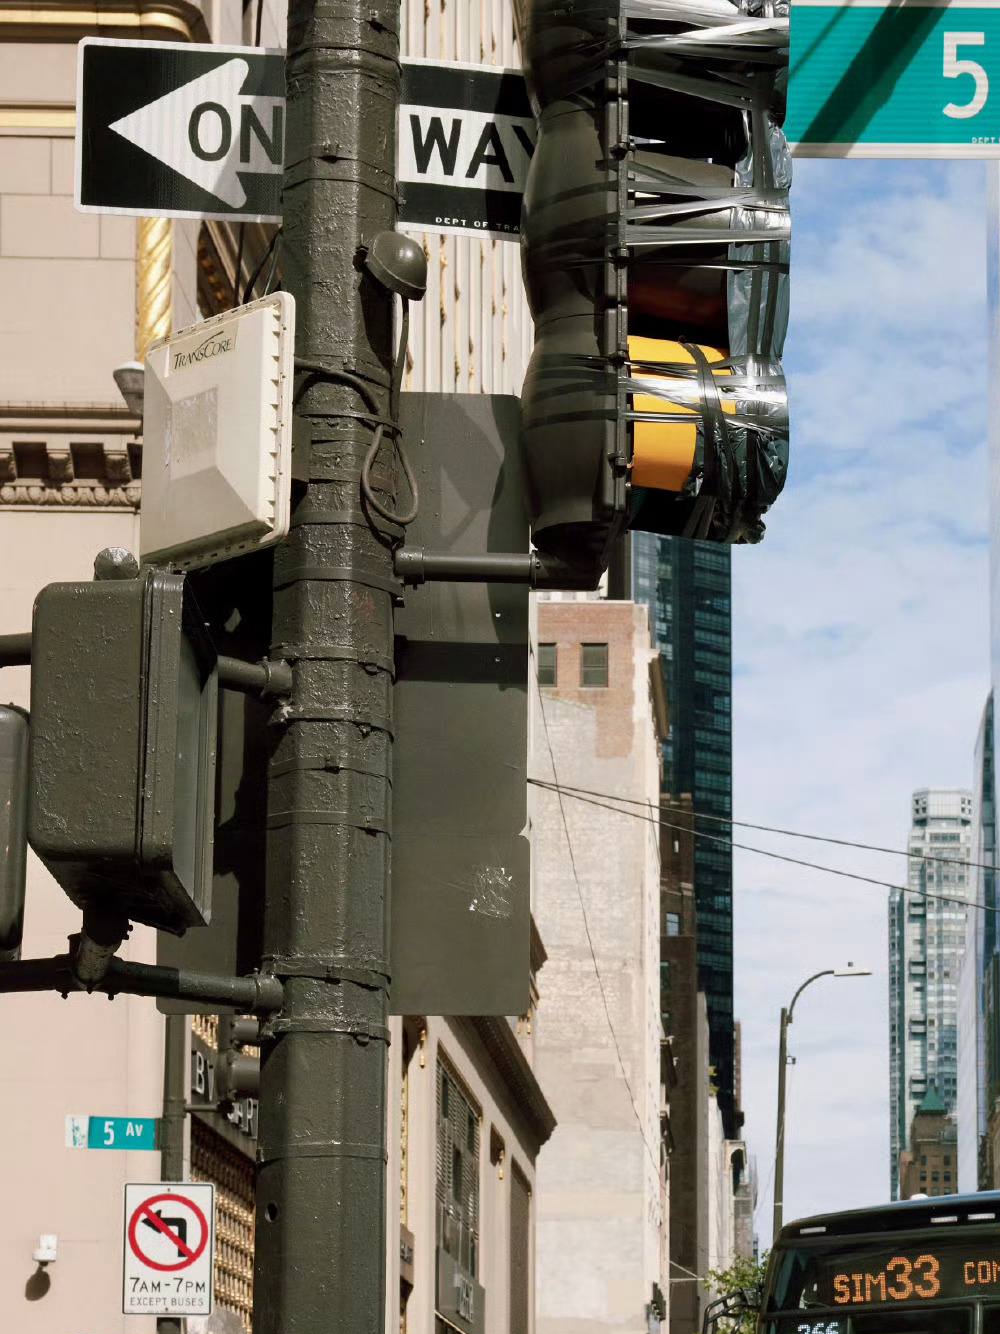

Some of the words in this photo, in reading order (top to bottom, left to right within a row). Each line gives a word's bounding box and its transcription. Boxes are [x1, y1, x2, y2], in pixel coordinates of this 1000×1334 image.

[942, 31, 989, 119] 5
[188, 101, 283, 165] ON
[971, 136, 996, 144] DEPT
[435, 216, 467, 226] DEPT
[473, 220, 489, 228] OF
[496, 223, 520, 231] TRA
[103, 1121, 115, 1145] 5
[833, 1254, 941, 1303] SIM33
[130, 1296, 167, 1306] EXCEPT
[170, 1297, 204, 1307] BUSES
